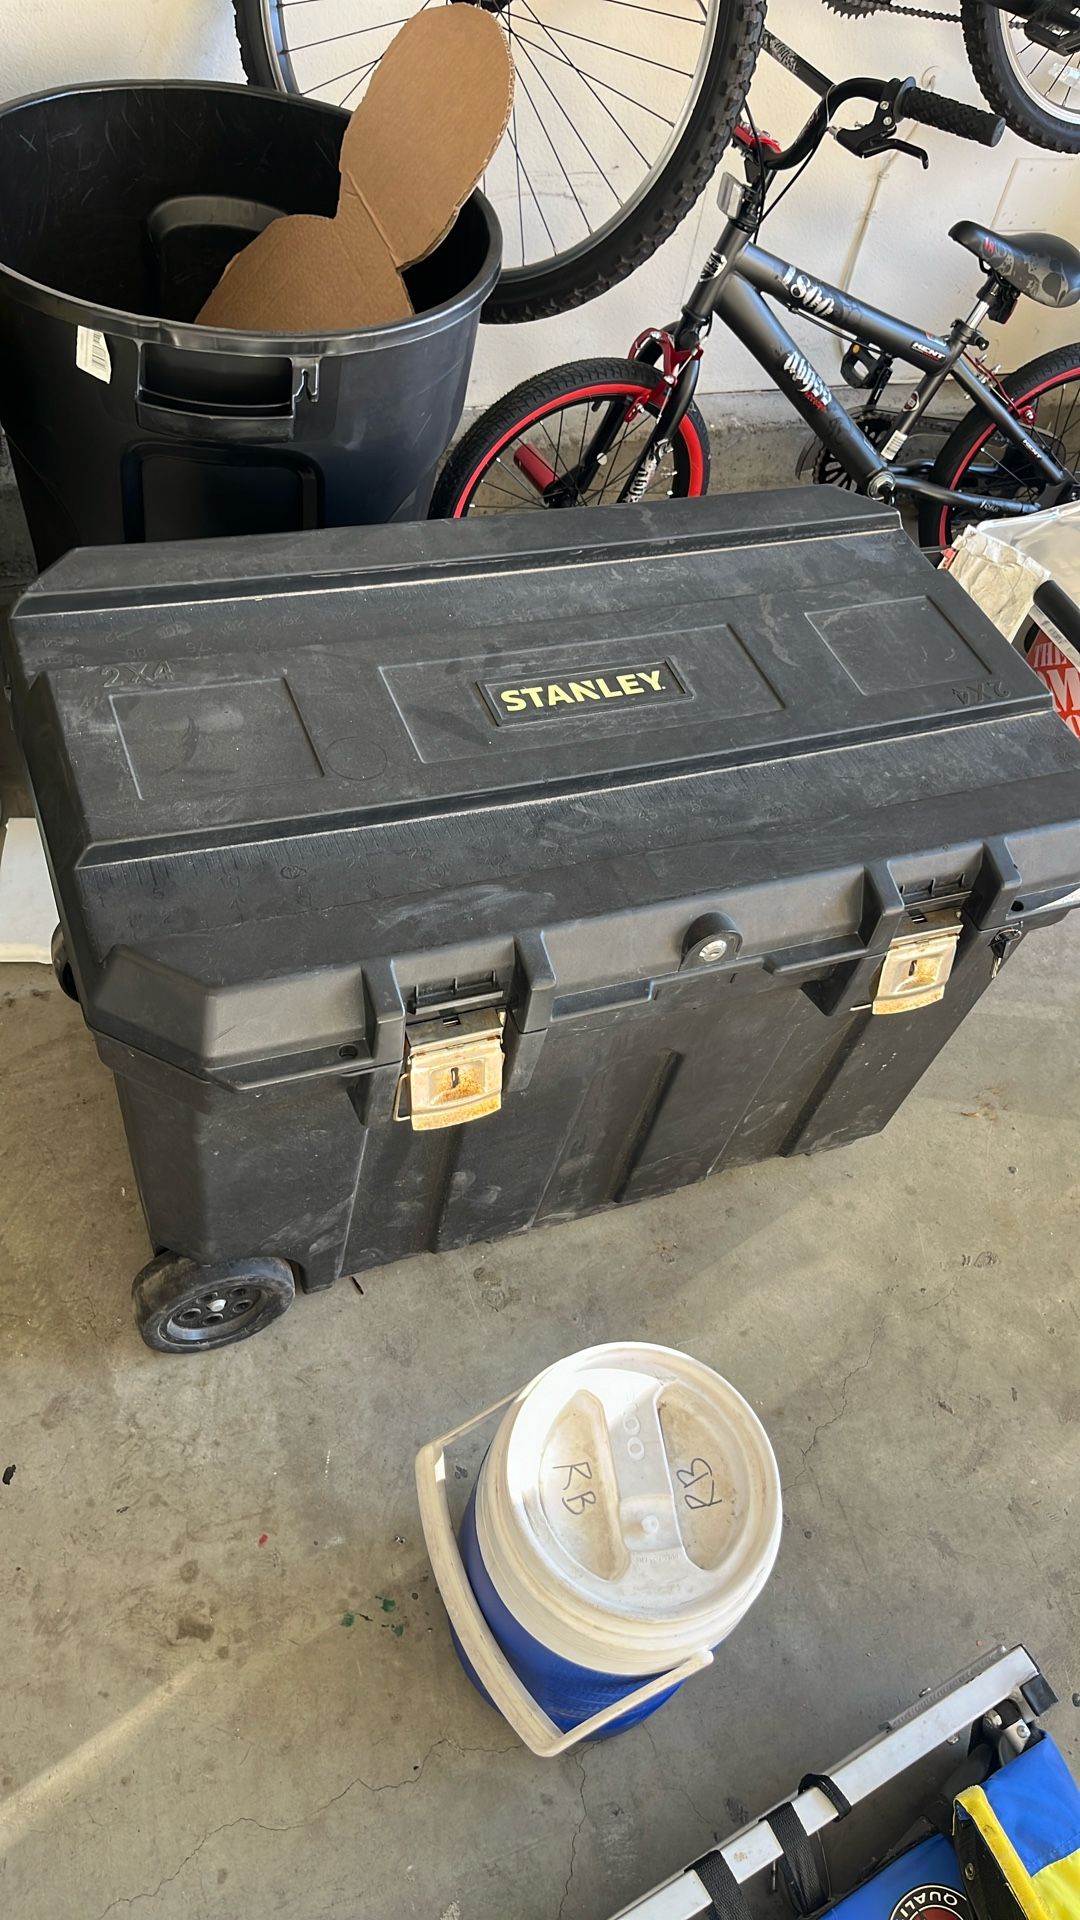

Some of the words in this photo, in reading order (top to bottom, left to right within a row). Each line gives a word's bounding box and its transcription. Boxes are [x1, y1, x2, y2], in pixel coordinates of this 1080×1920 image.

[911, 342, 946, 359] KENT
[500, 669, 667, 712] STANLEY
[552, 1461, 597, 1516] RB
[676, 1457, 723, 1510] RB
[895, 1891, 958, 1920] QUALI
